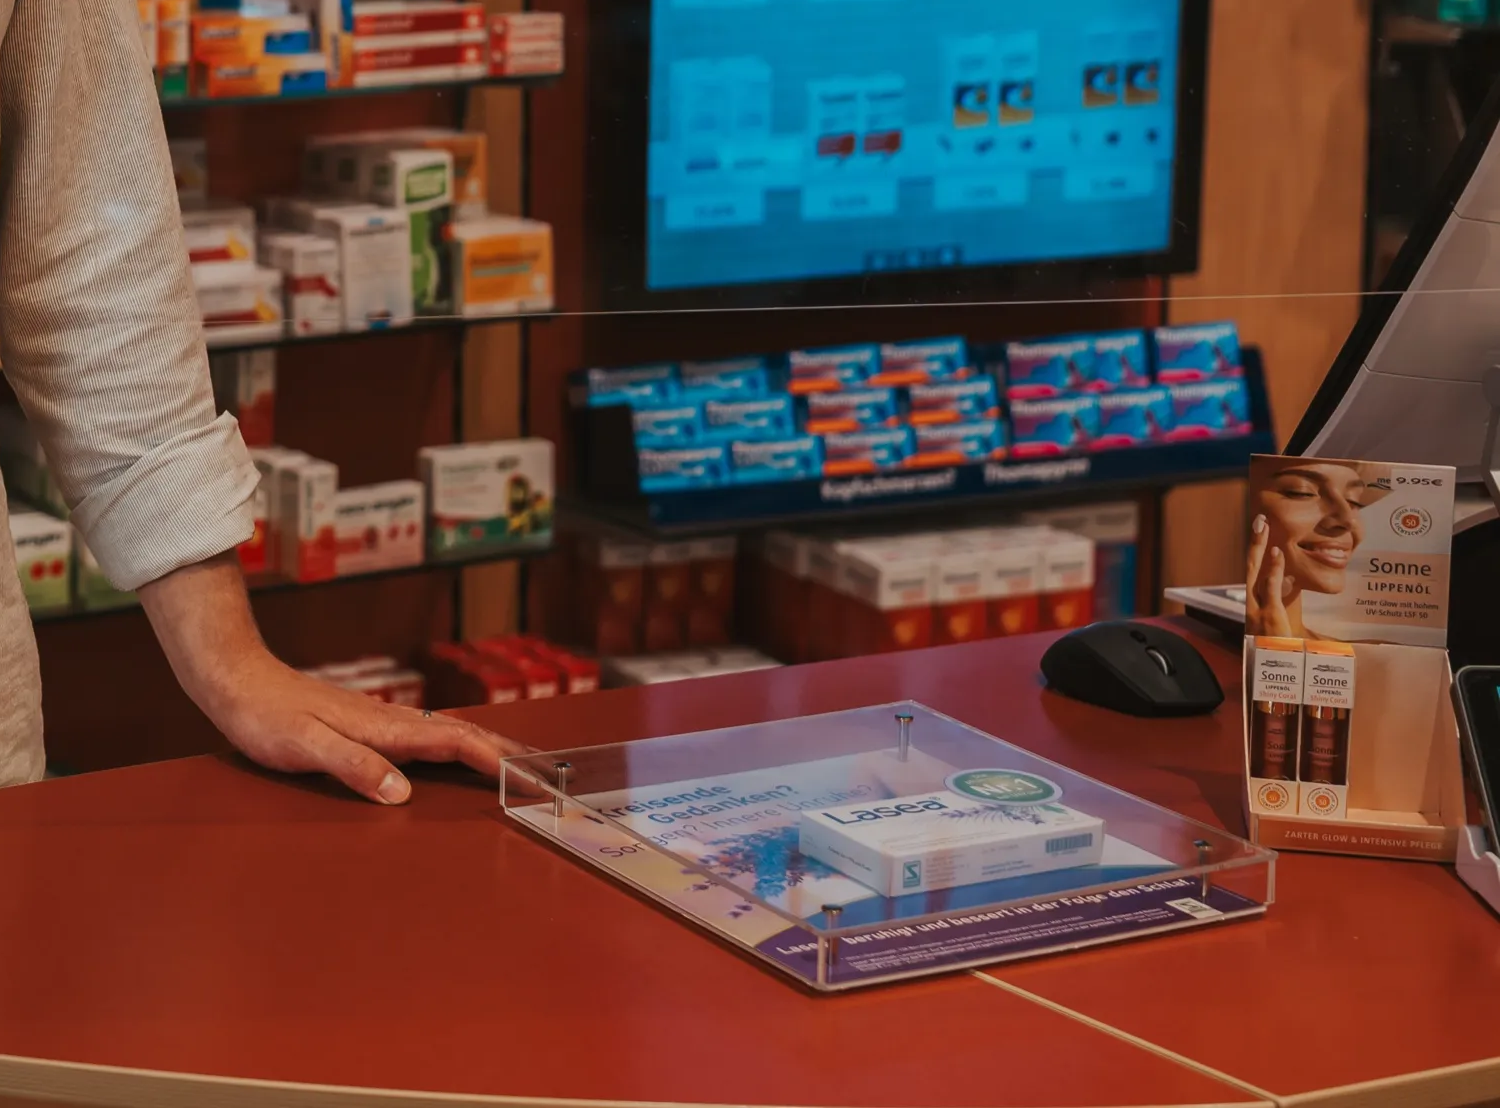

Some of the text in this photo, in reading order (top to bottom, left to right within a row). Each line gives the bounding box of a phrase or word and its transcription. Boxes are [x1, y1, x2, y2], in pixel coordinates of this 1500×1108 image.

[1396, 476, 1443, 487] 9.95€
[1406, 519, 1416, 527] 50
[1369, 558, 1432, 576] Sonne
[1367, 582, 1431, 594] LIPPENÖL
[1356, 598, 1439, 610] Zarter Glow mit hohem
[1366, 608, 1402, 618] UV-Schutz
[1405, 611, 1416, 619] LSF
[1261, 671, 1296, 683] Sonne
[1313, 675, 1348, 687] Sonne
[1259, 691, 1297, 700] Shiny Coral
[1310, 695, 1348, 705] Shiny Coral
[648, 784, 799, 825] Gedanken?
[704, 805, 782, 831] Innere
[1285, 830, 1444, 850] ZARTER GLOW & INTENSIVE PFLEGE
[841, 925, 917, 945] beruhigt
[916, 919, 951, 933] und
[947, 907, 1014, 926] bessert
[1010, 906, 1033, 915] in
[1032, 899, 1060, 912] der
[1059, 894, 1108, 908] Folge
[1108, 886, 1140, 898] den
